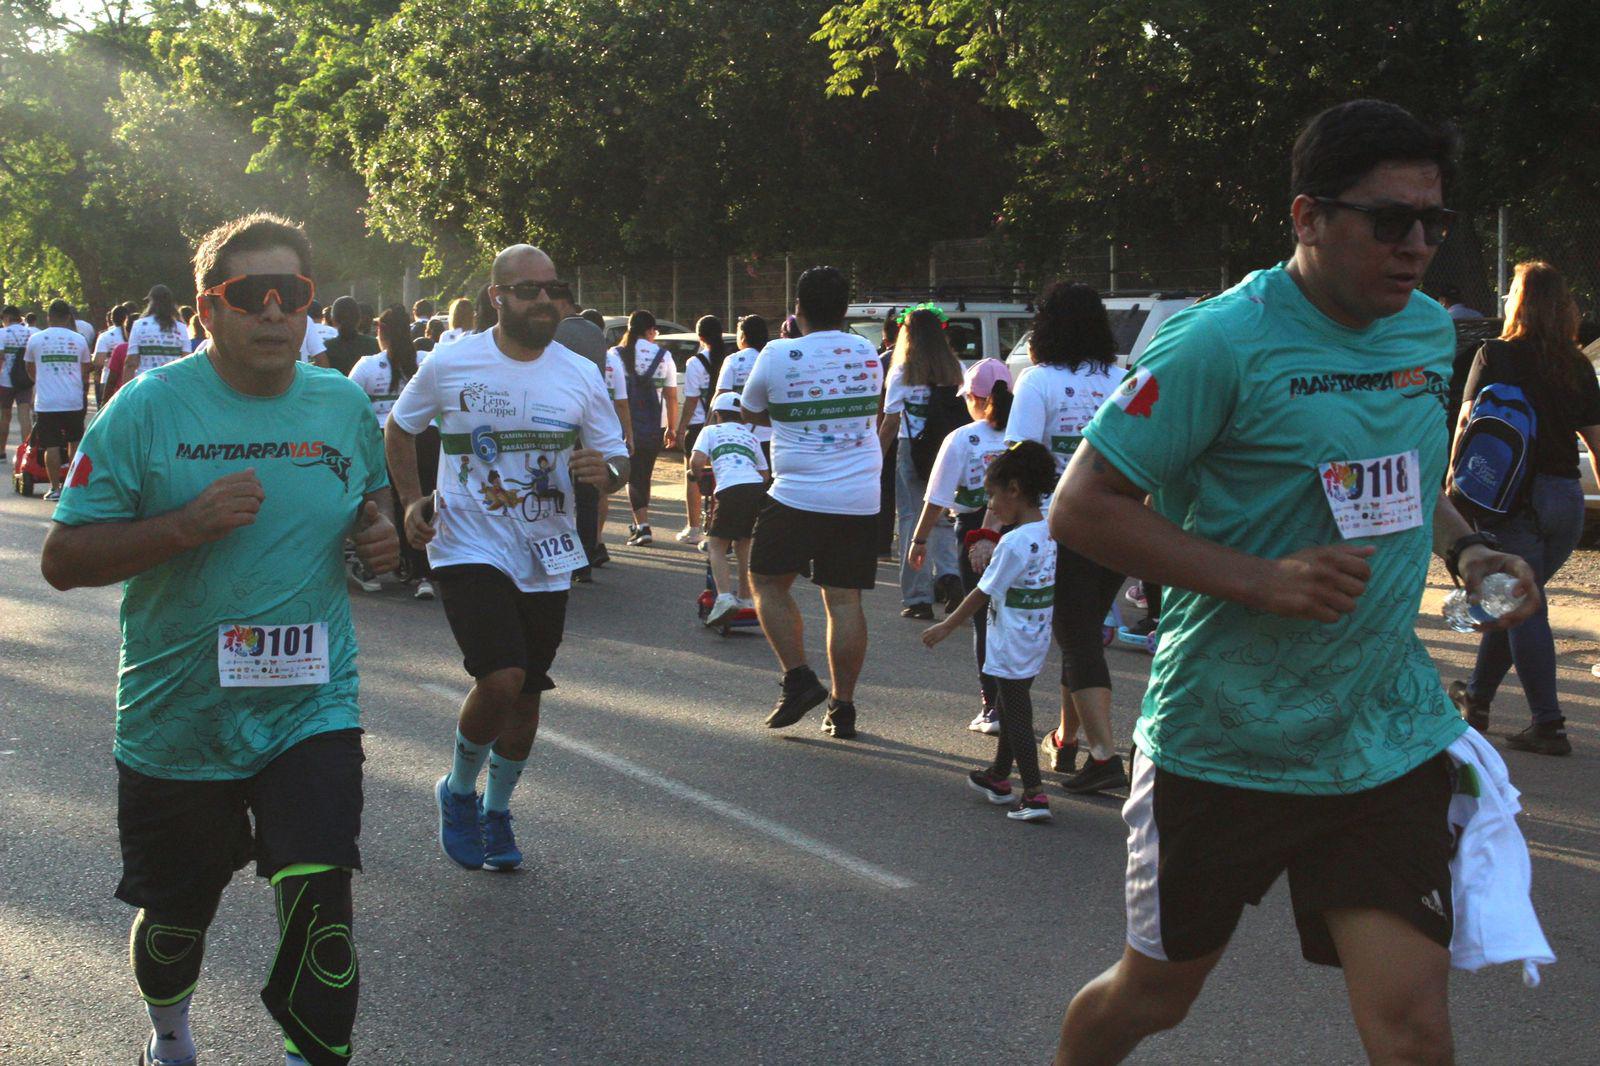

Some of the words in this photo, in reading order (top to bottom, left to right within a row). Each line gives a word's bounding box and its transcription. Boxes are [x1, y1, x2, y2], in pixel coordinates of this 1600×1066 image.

[1290, 366, 1426, 398] MANTARRAYAS
[483, 395, 507, 408] Letty
[482, 405, 516, 418] Coppel
[175, 441, 325, 460] MANTARRAYAS
[249, 625, 314, 657] 0101
